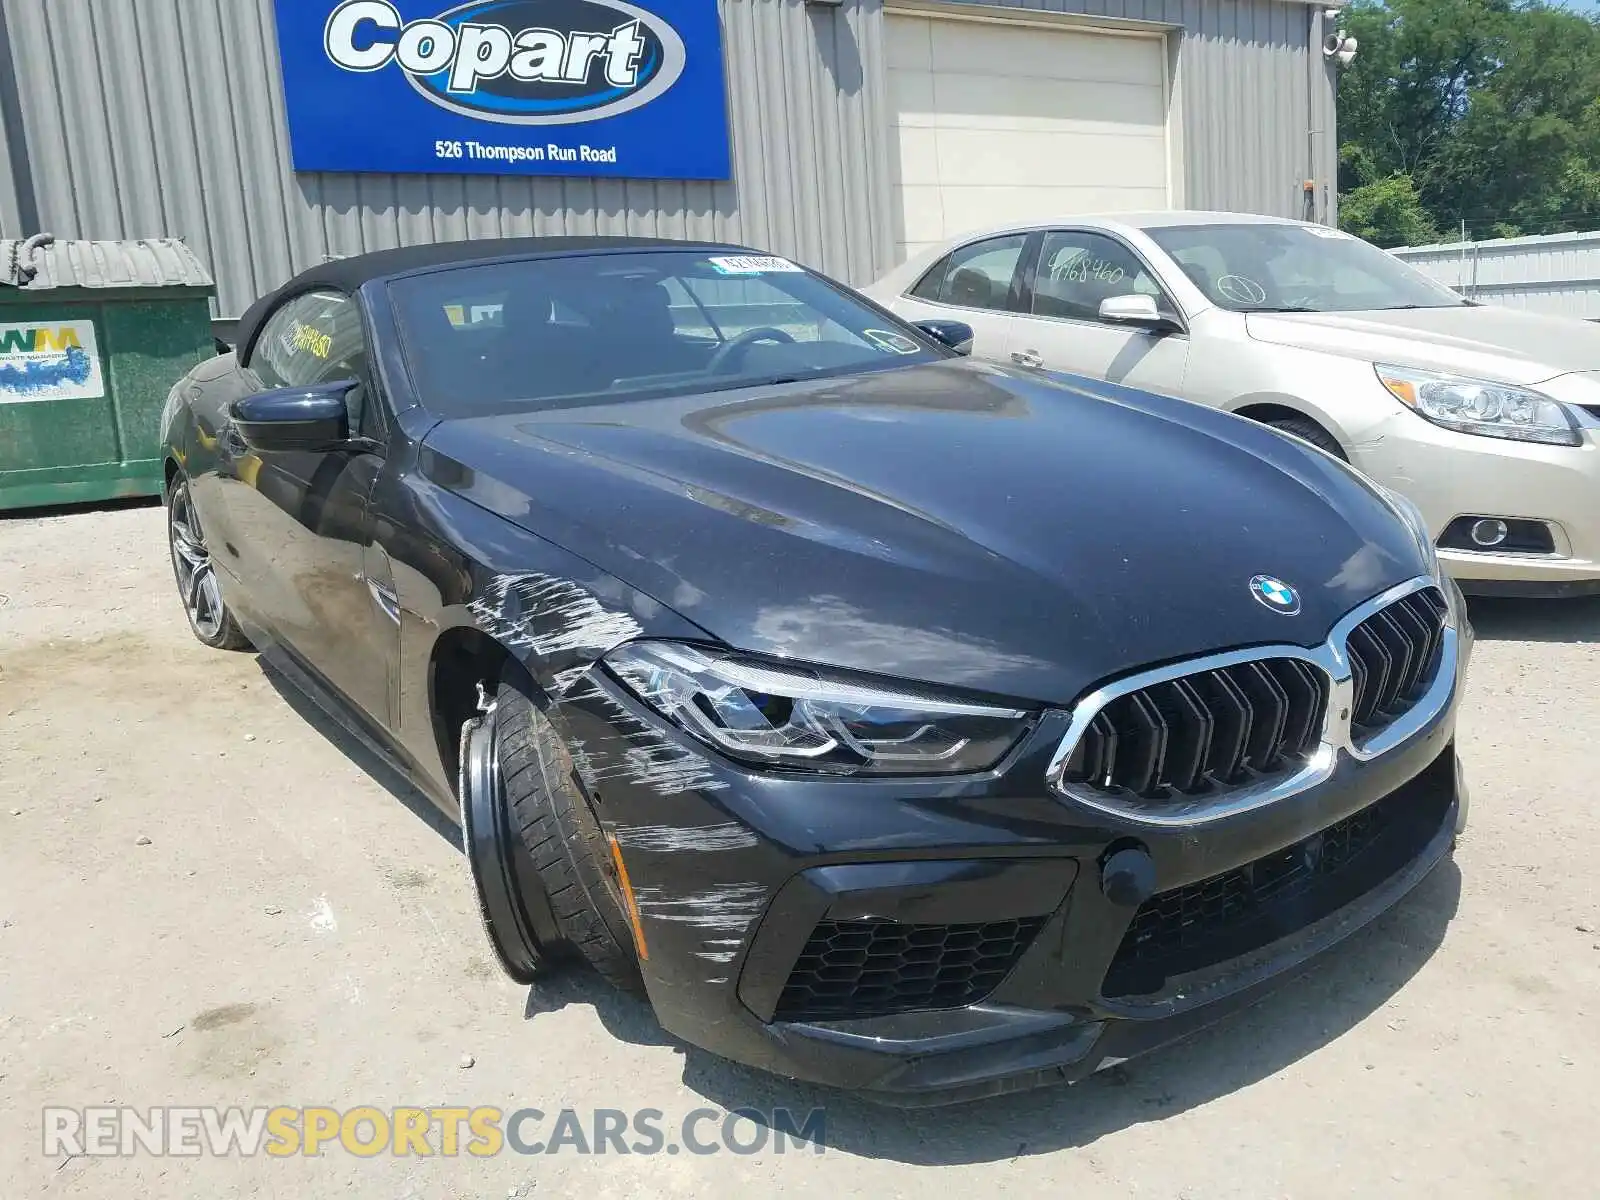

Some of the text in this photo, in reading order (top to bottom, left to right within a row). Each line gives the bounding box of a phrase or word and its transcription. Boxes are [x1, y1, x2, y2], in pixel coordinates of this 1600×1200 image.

[324, 0, 645, 94] Copart
[435, 141, 617, 164] 526 Thompson Run Road
[0, 327, 80, 353] WM
